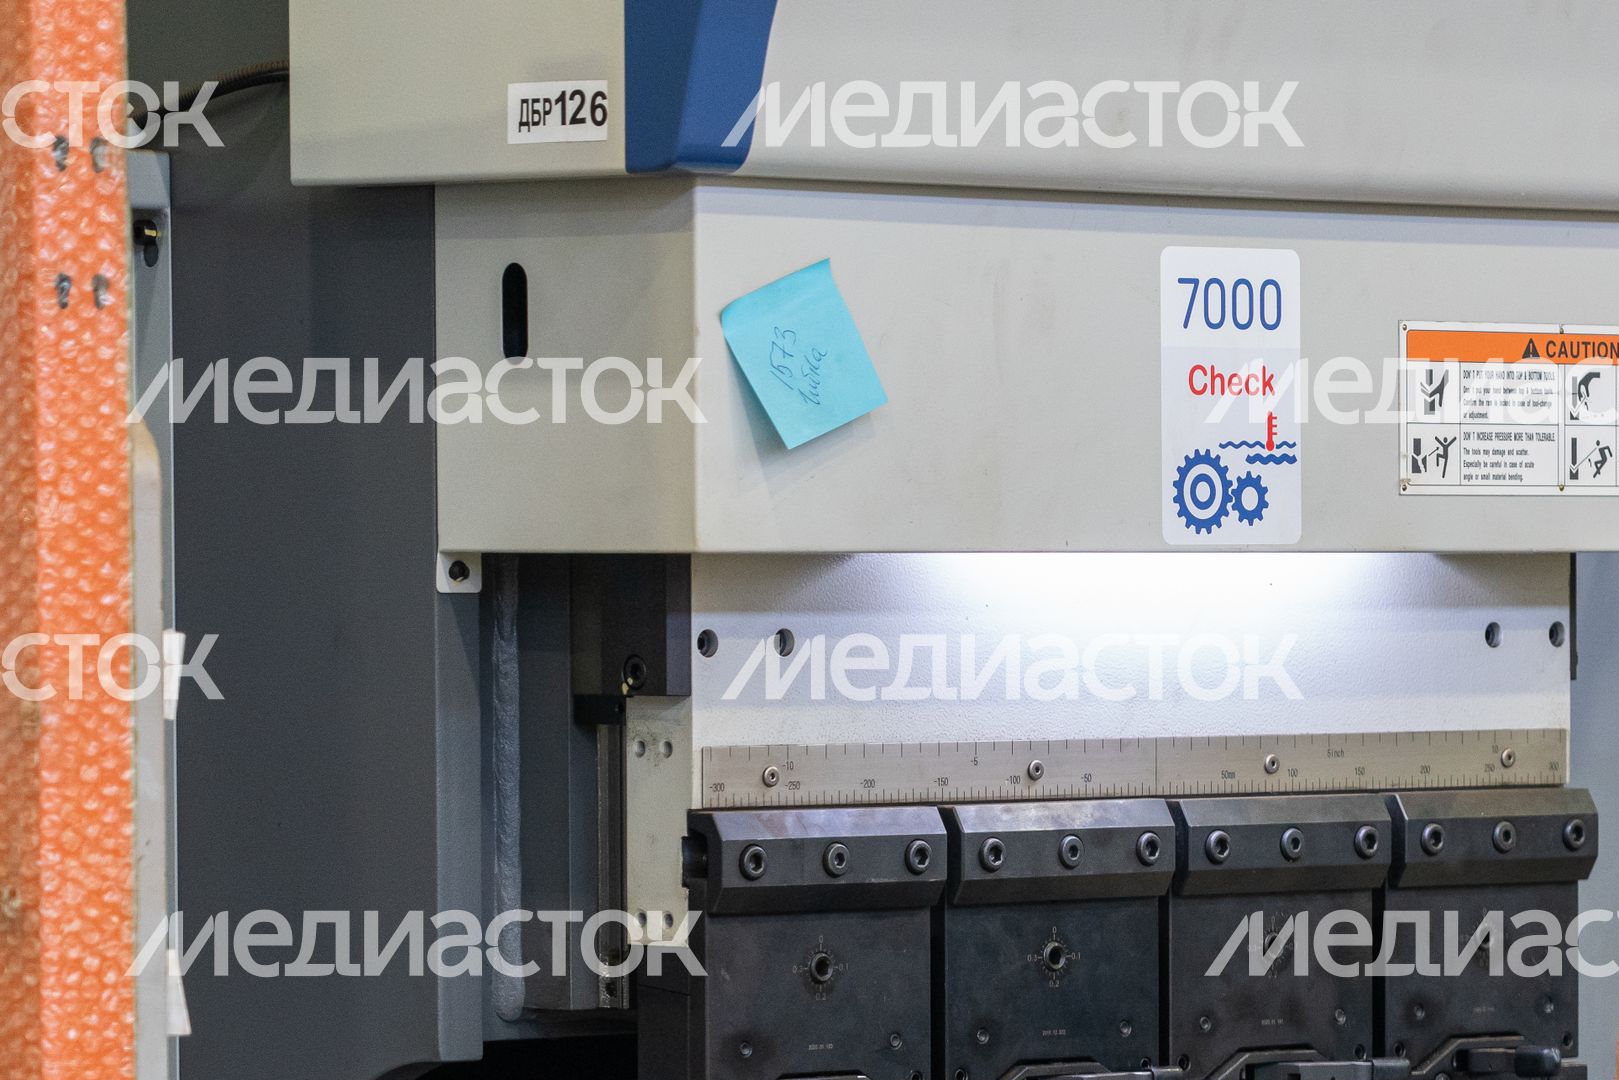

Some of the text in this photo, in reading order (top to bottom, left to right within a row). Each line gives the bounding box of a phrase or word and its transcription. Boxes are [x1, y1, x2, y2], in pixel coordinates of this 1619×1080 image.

[518, 89, 607, 132] ДБР126
[1177, 277, 1282, 331] 7000
[1545, 340, 1619, 358] CAUTION
[1188, 364, 1275, 396] Check
[709, 783, 725, 792] -300
[785, 781, 800, 790] -250
[860, 779, 875, 788] -200
[933, 777, 949, 786] -150
[1006, 775, 1020, 784] -100
[1081, 773, 1092, 782] -50
[1287, 768, 1298, 777] 100
[1354, 767, 1365, 776] 150
[1420, 765, 1431, 774] 200
[1484, 764, 1495, 772] 250
